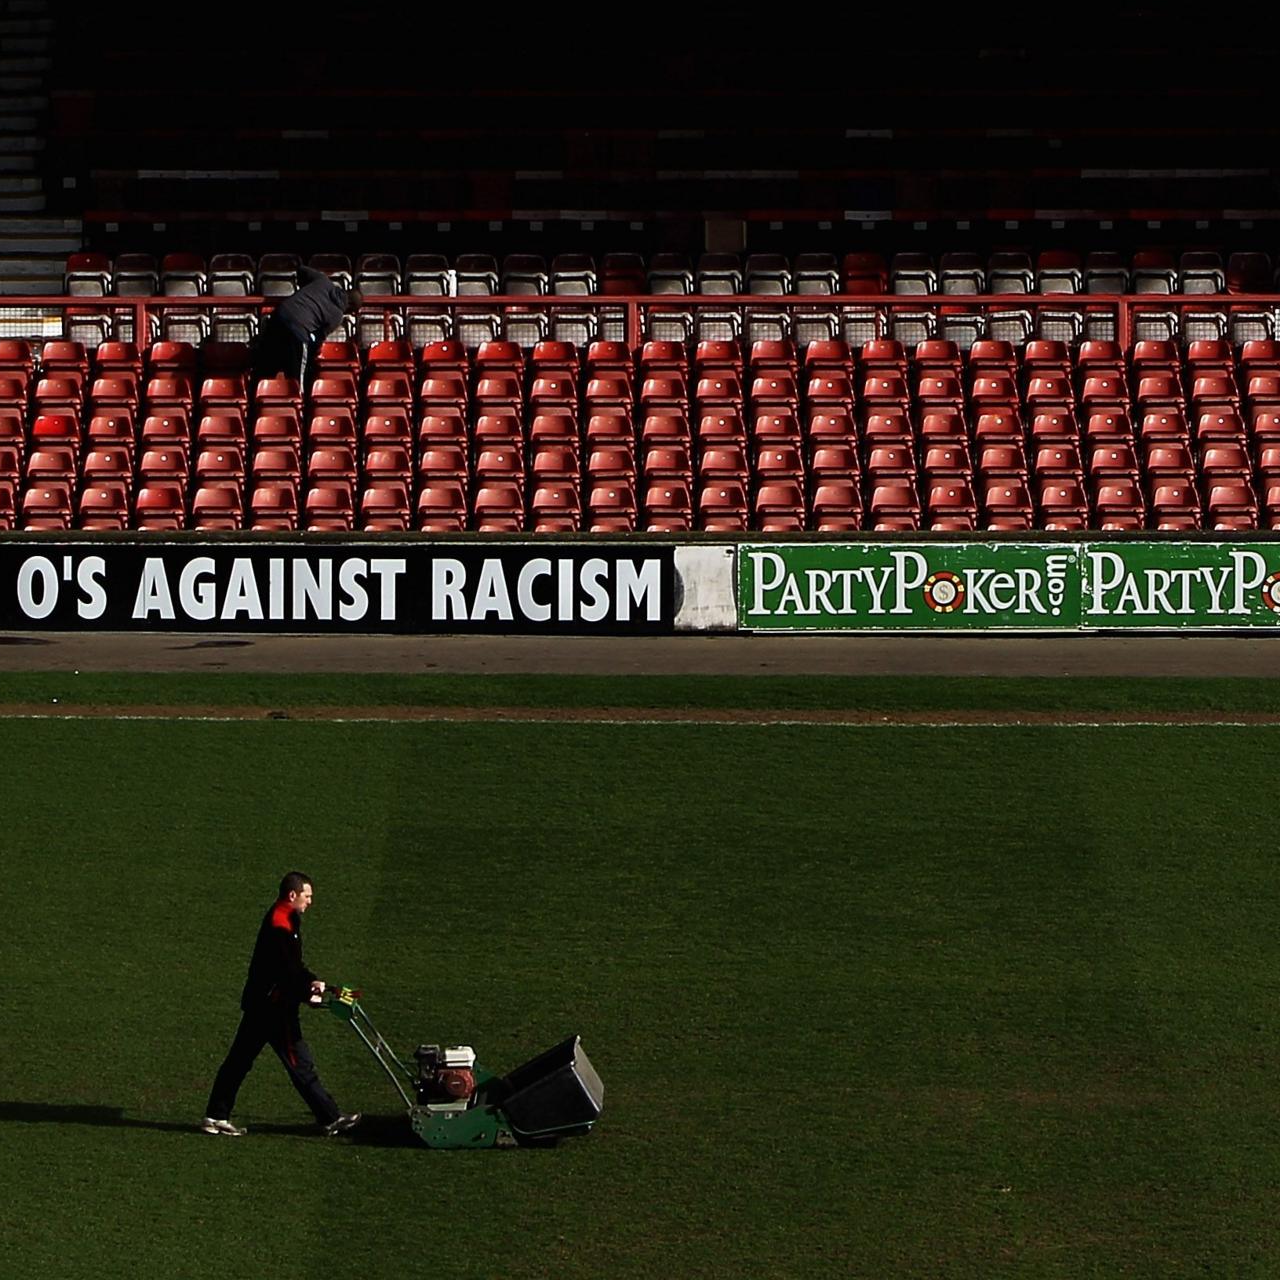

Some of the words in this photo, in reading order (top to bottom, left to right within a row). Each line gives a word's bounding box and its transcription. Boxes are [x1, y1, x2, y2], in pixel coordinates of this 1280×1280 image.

[16, 555, 107, 619] O'S
[132, 556, 407, 621] AGAINST
[431, 557, 662, 621] RACISM
